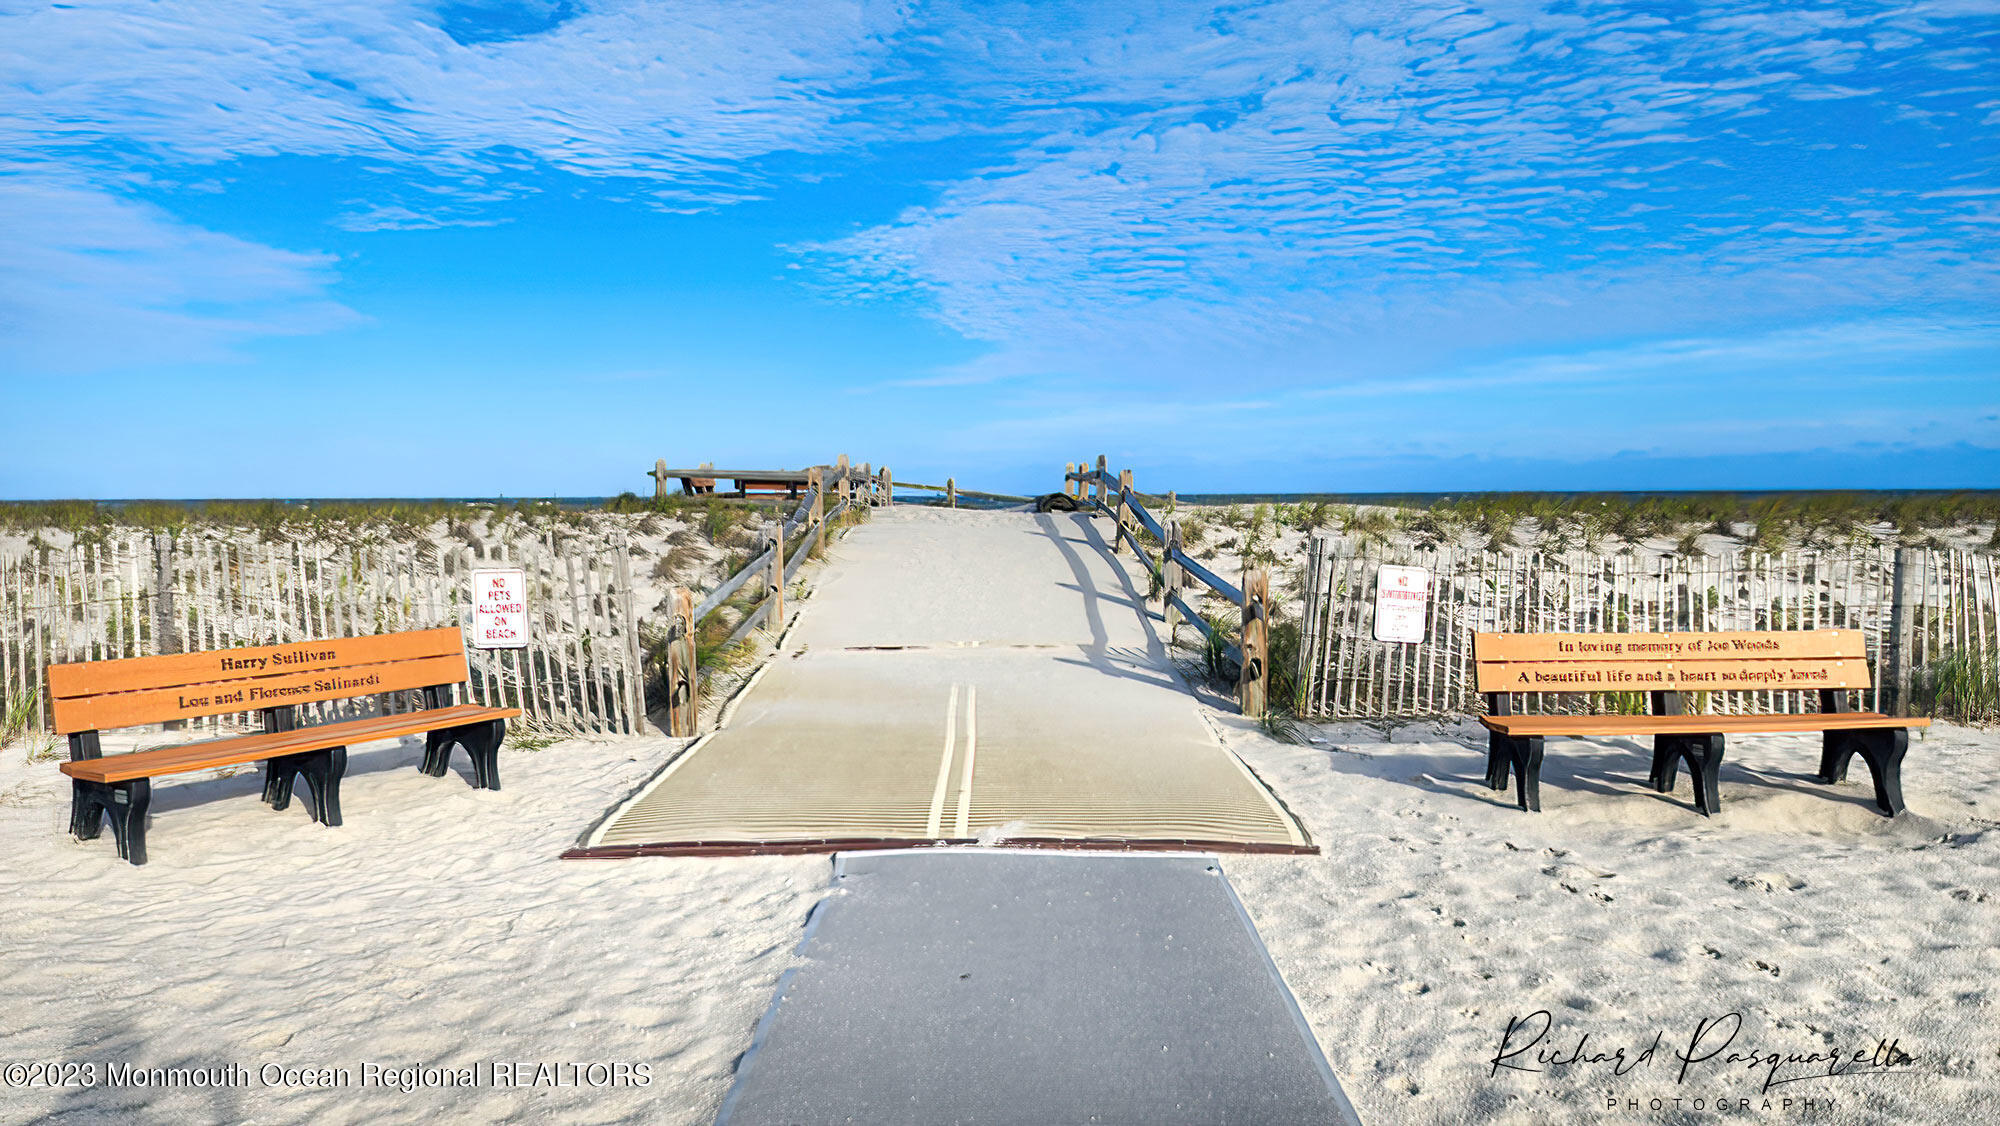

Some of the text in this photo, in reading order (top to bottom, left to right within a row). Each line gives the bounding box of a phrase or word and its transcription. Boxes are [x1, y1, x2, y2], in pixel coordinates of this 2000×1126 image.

[492, 578, 505, 588] NO
[488, 590, 511, 601] PETS
[479, 603, 522, 614] ALLOWED
[494, 616, 507, 626] ON
[486, 628, 517, 639] BEACH
[1558, 640, 1574, 652] In
[1578, 640, 1622, 654] loving
[1627, 642, 1683, 653] memory
[1688, 639, 1704, 651] of
[220, 650, 336, 671] Harry Sullivan
[1518, 671, 1530, 683] A
[1535, 670, 1601, 683] beautiful
[1607, 670, 1632, 682] life
[1637, 670, 1663, 682] and
[1679, 669, 1717, 682] heart
[1739, 668, 1786, 683] deeply
[179, 672, 380, 709] Lou and Florence Salinardi
